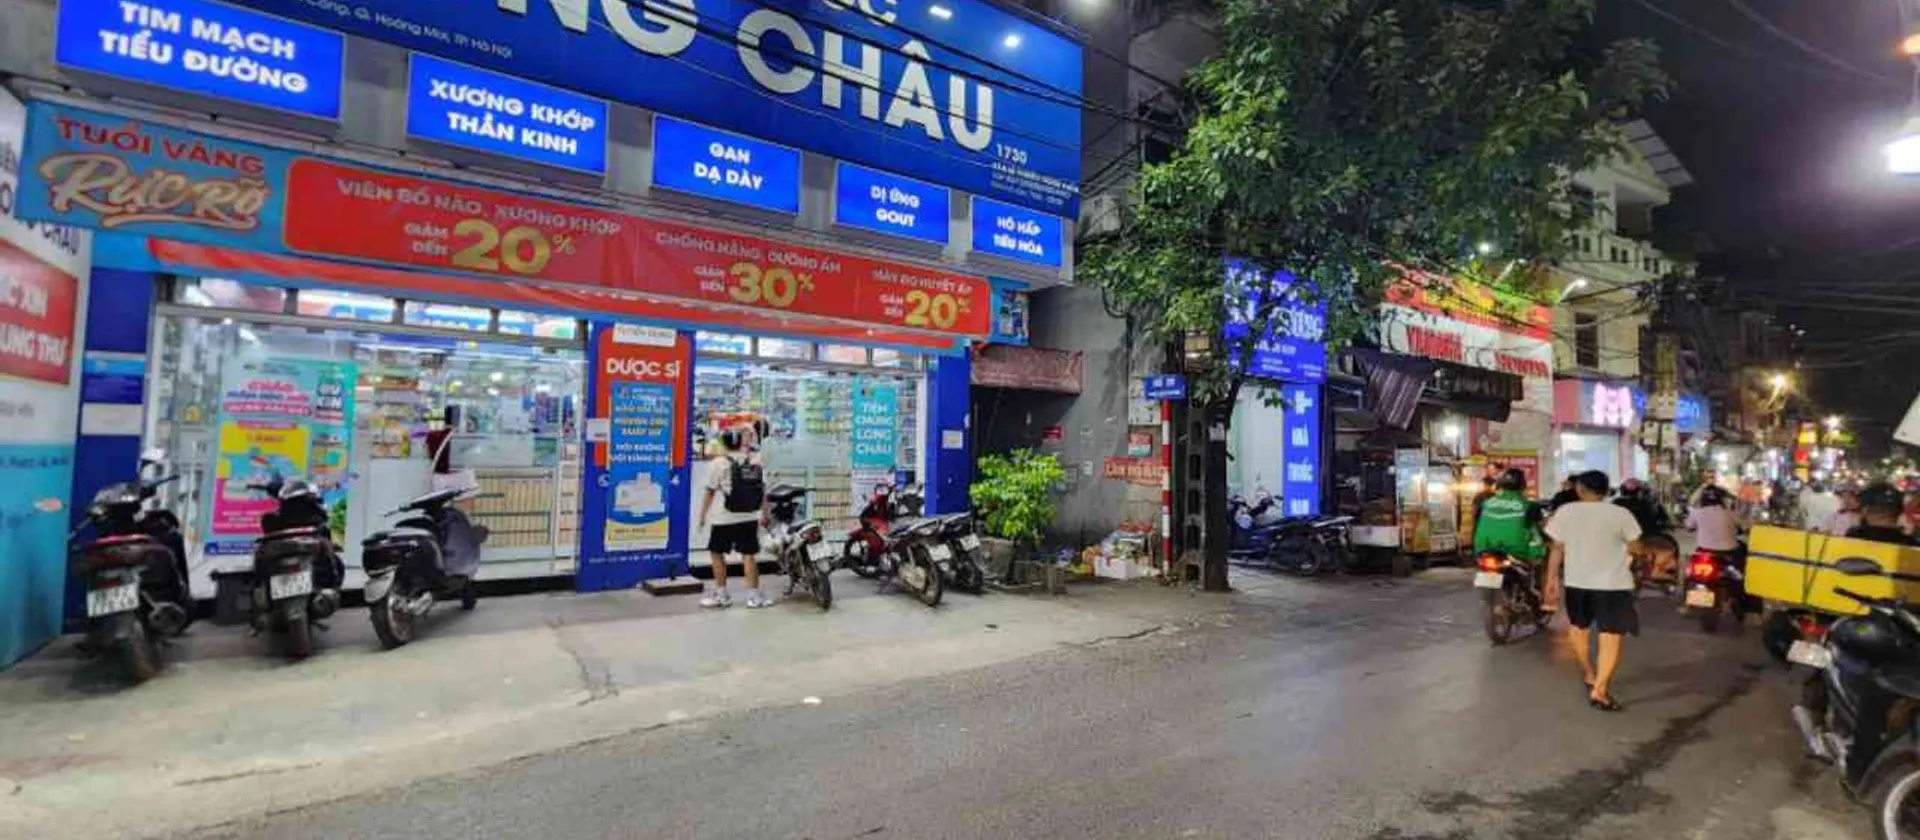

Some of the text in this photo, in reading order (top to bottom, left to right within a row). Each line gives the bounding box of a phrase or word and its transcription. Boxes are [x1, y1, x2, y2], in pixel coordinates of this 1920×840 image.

[120, 1, 296, 60] TIM MẠCH
[183, 49, 308, 93] ĐƯỜNG
[736, 8, 993, 151] CHÂU
[429, 79, 596, 132] XƯƠNG KHỚP
[522, 127, 577, 156] KINH
[709, 141, 751, 164] GAN
[163, 138, 266, 176] VÀNG
[694, 161, 763, 191] DẠ DÀY
[337, 178, 392, 201] VIÊN
[397, 184, 432, 208] BỔ
[495, 203, 566, 230] XƯƠNG
[569, 213, 622, 237] KHỚP
[870, 185, 921, 209] DỊ ỨNG
[403, 220, 449, 238] GIẢM
[876, 207, 916, 228] GOUT
[412, 237, 448, 256] ĐẾN
[656, 231, 714, 251] CHỐNG
[606, 358, 682, 380] DƯỢC SĨ
